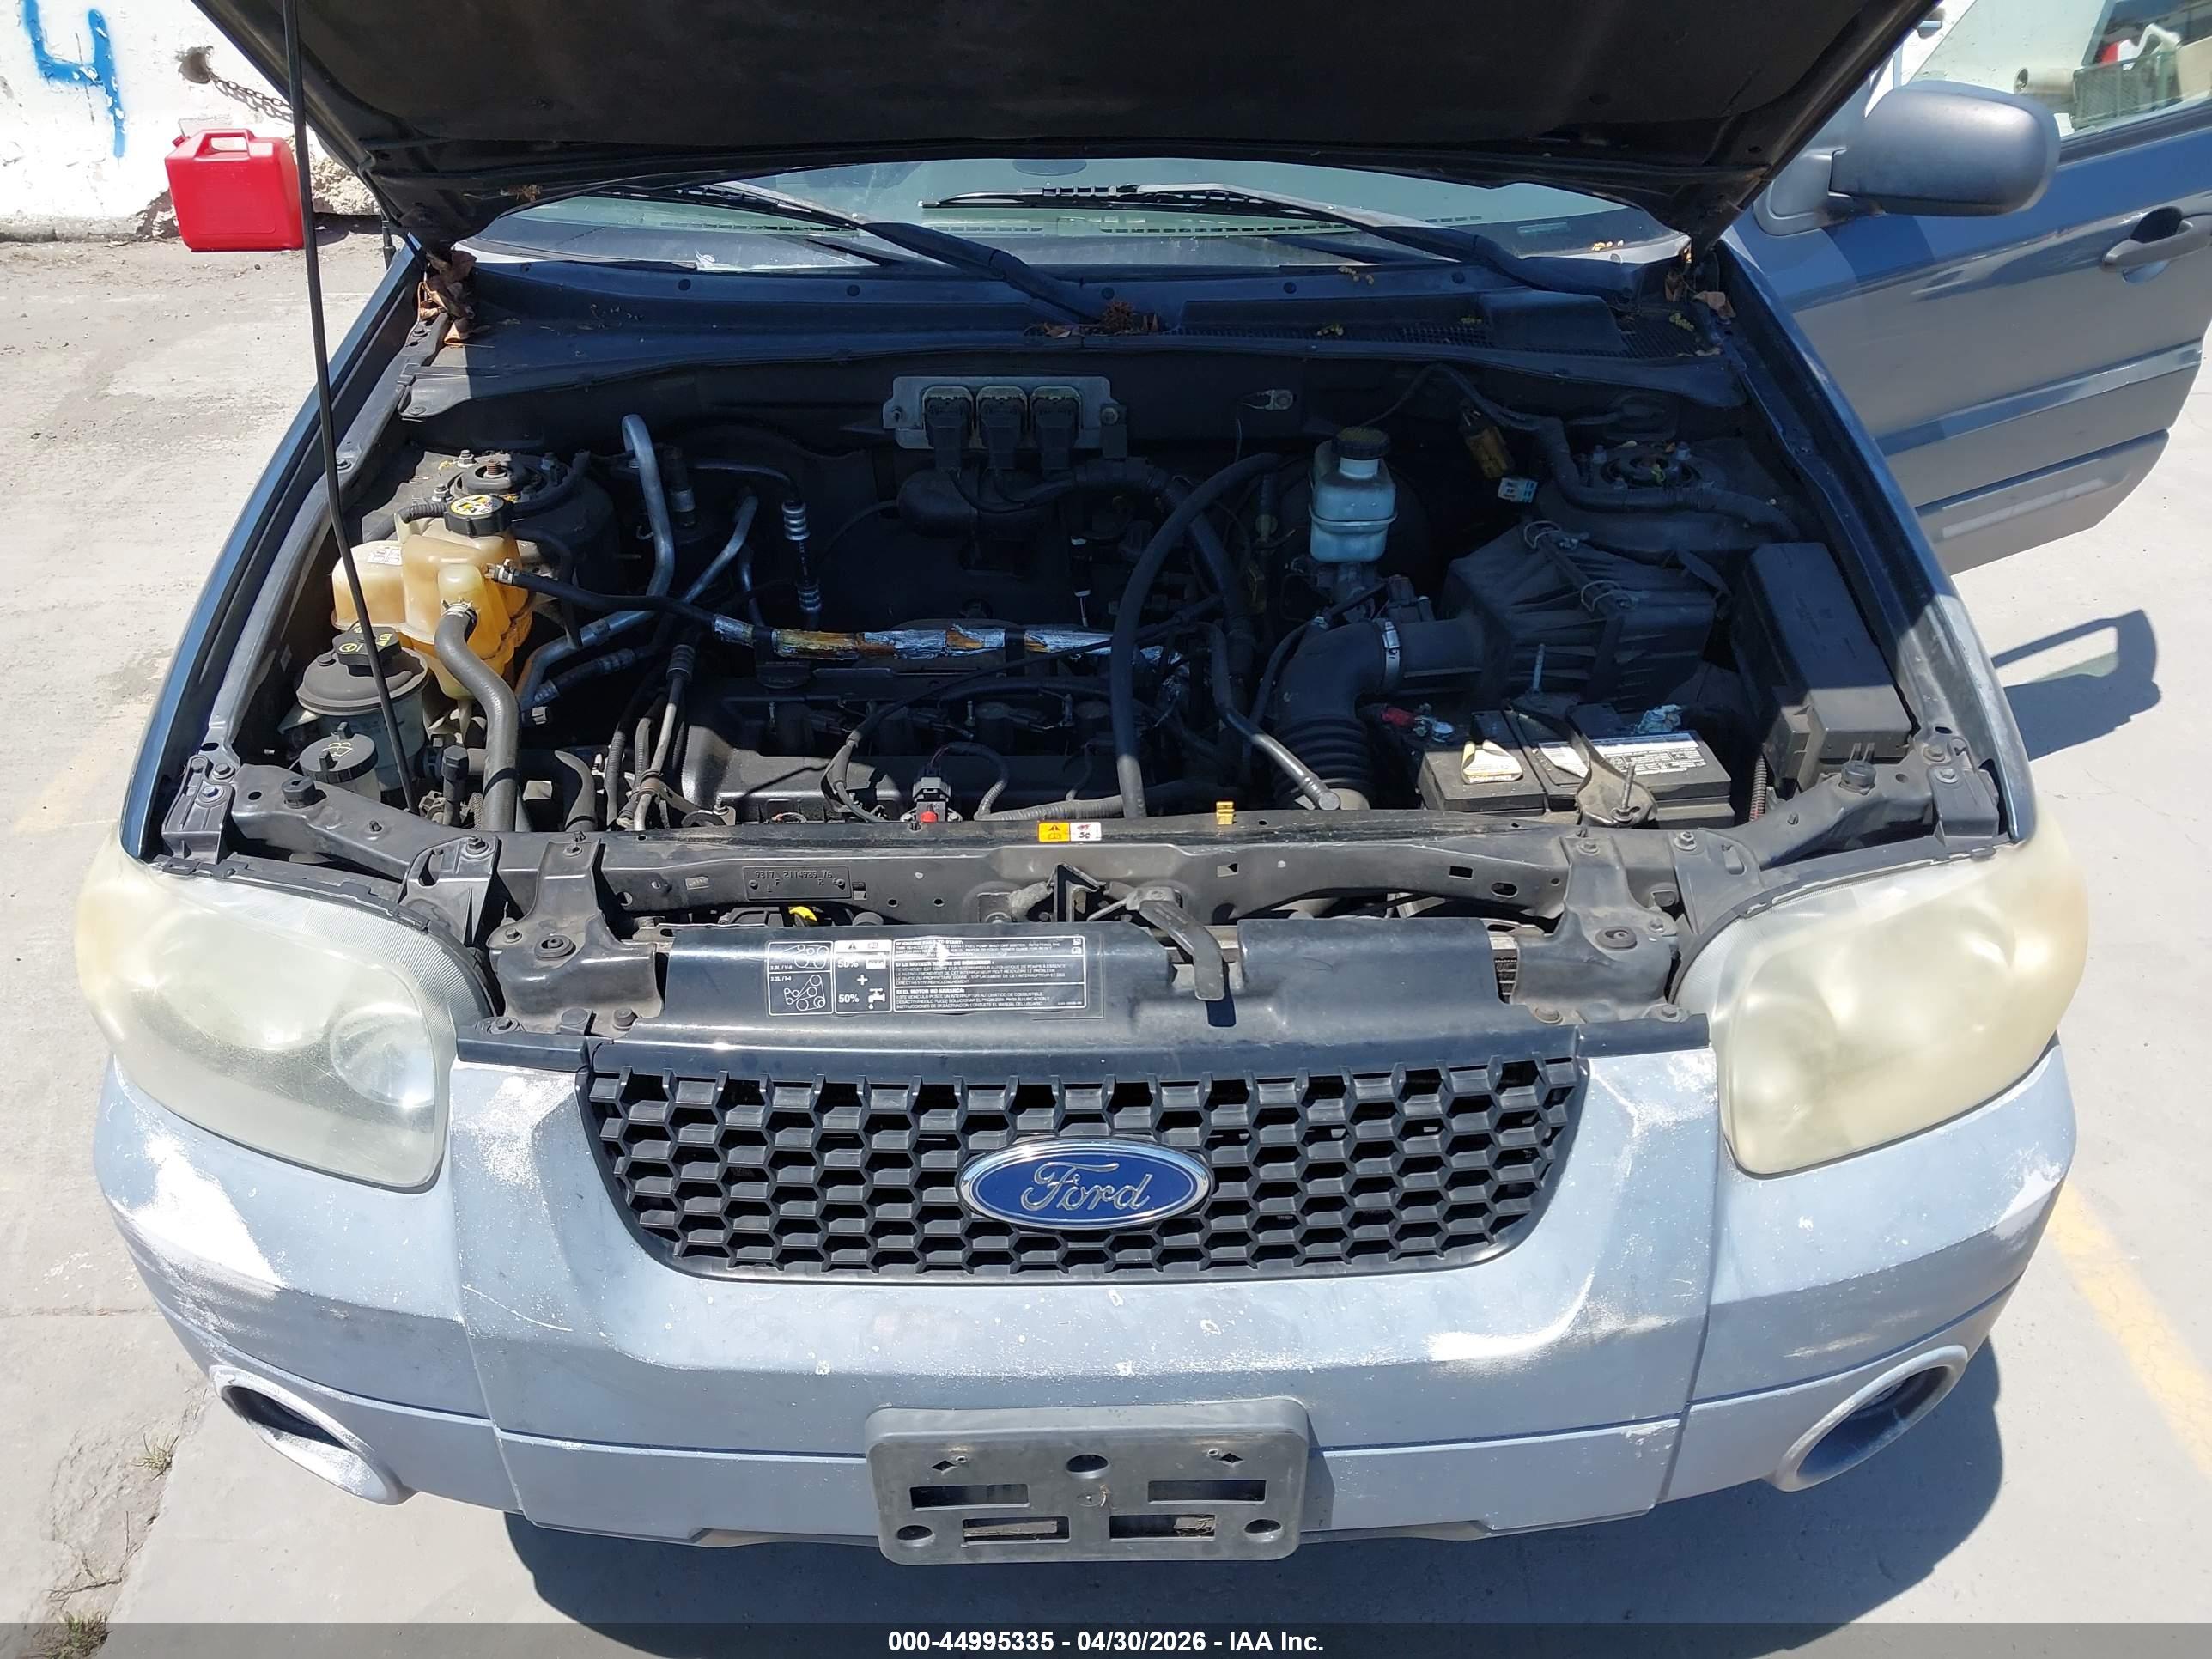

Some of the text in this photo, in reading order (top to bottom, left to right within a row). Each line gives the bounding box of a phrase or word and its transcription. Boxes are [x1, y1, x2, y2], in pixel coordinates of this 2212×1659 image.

[24, 0, 125, 160] 4
[838, 994, 860, 1003] 50%
[1020, 1161, 1153, 1211] Ford
